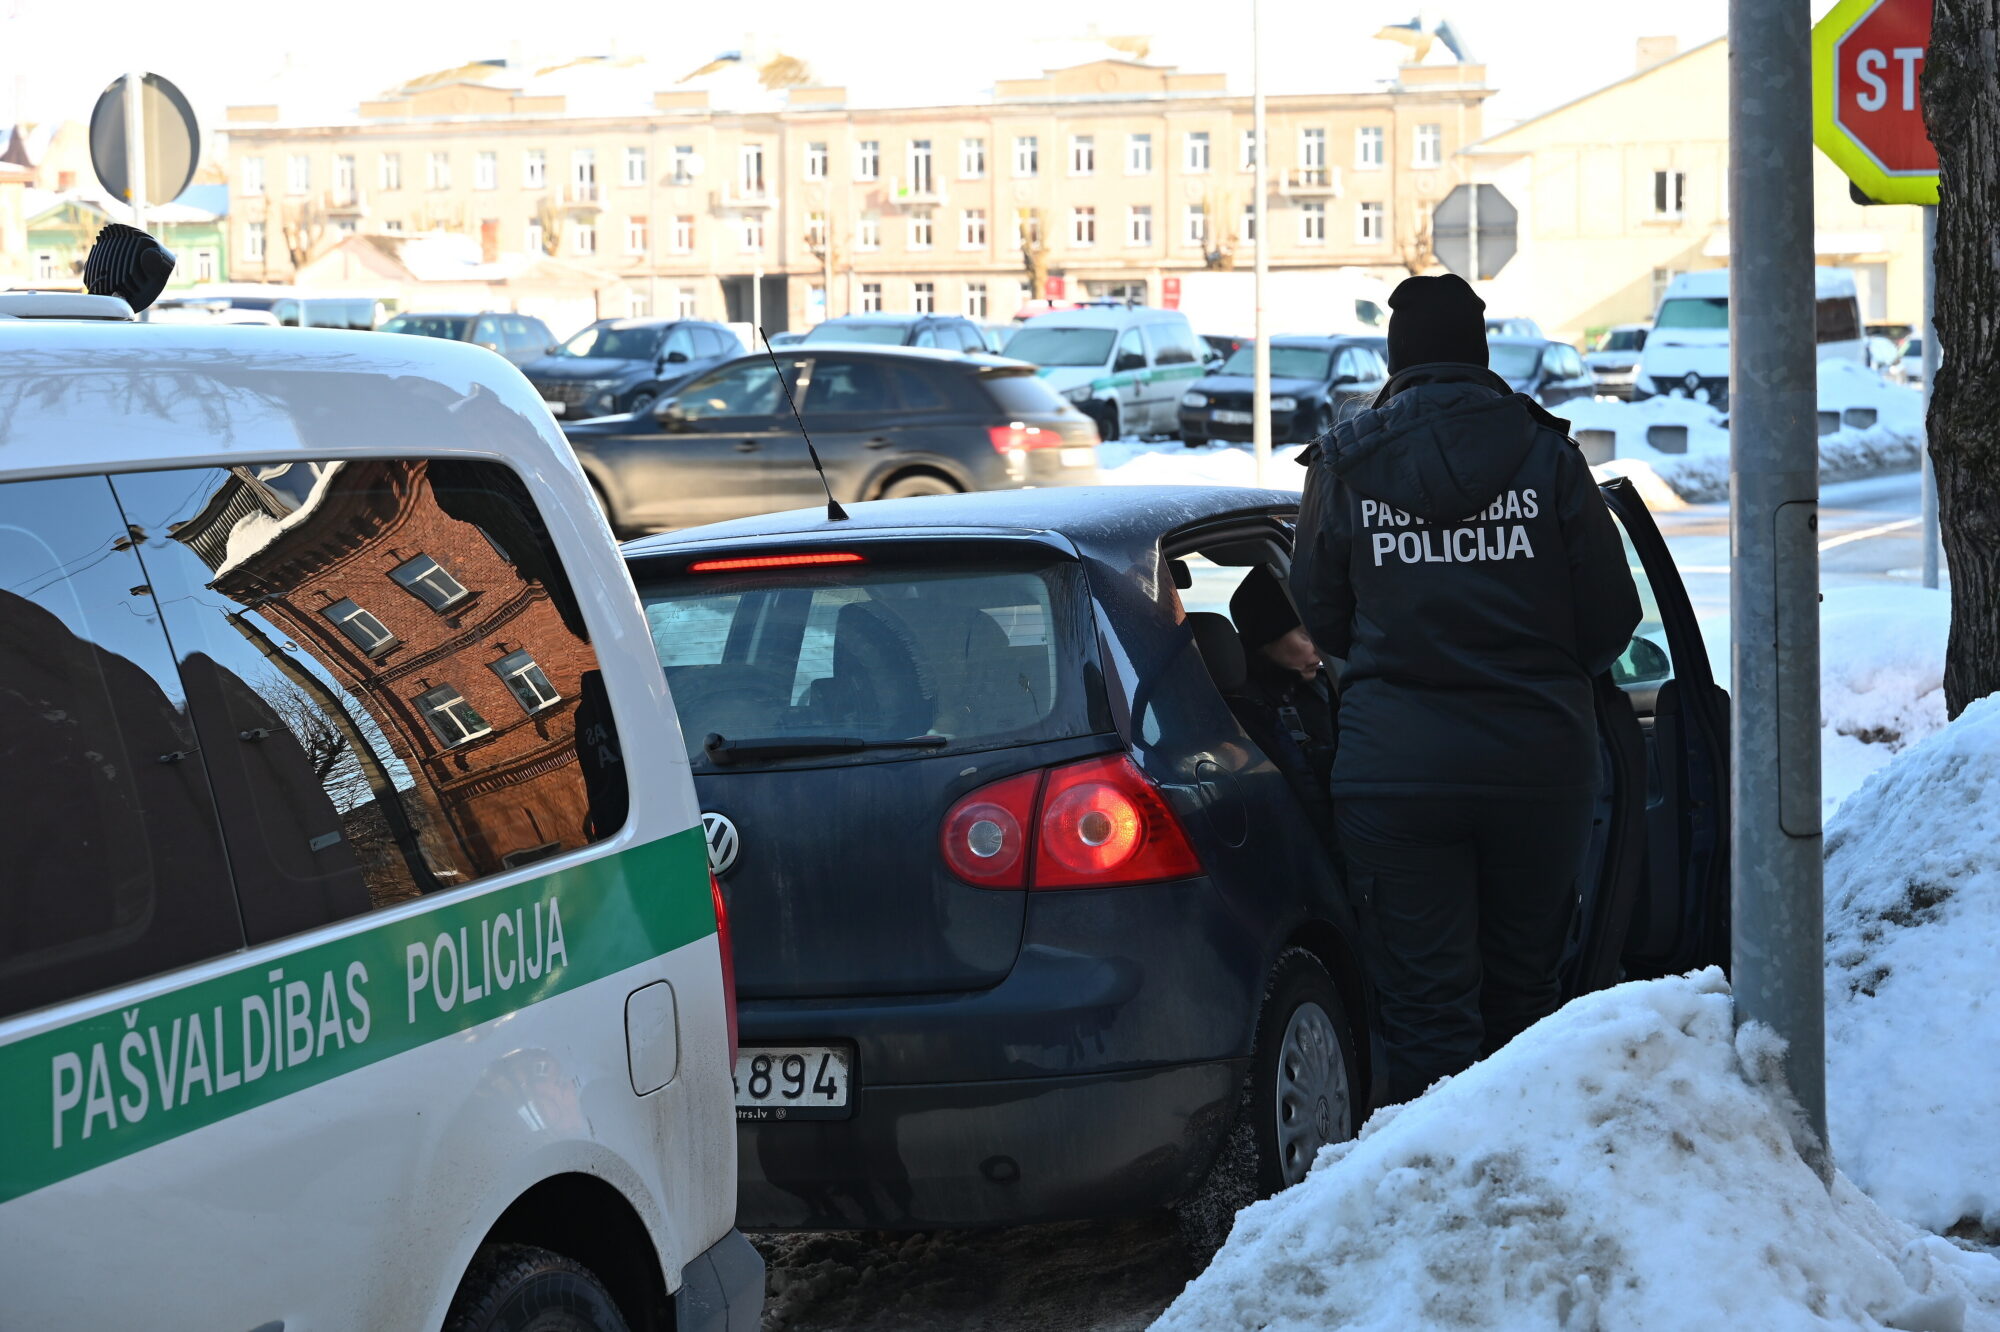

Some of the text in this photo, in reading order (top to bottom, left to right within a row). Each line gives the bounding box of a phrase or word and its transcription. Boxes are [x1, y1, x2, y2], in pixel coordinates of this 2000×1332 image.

[1856, 47, 1924, 112] ST
[1372, 525, 1535, 567] POLICIJA
[52, 896, 568, 1149] PAŠVALDĪBAS POLICIJA
[734, 1053, 837, 1100] 894
[736, 1107, 768, 1119] trs.lv
